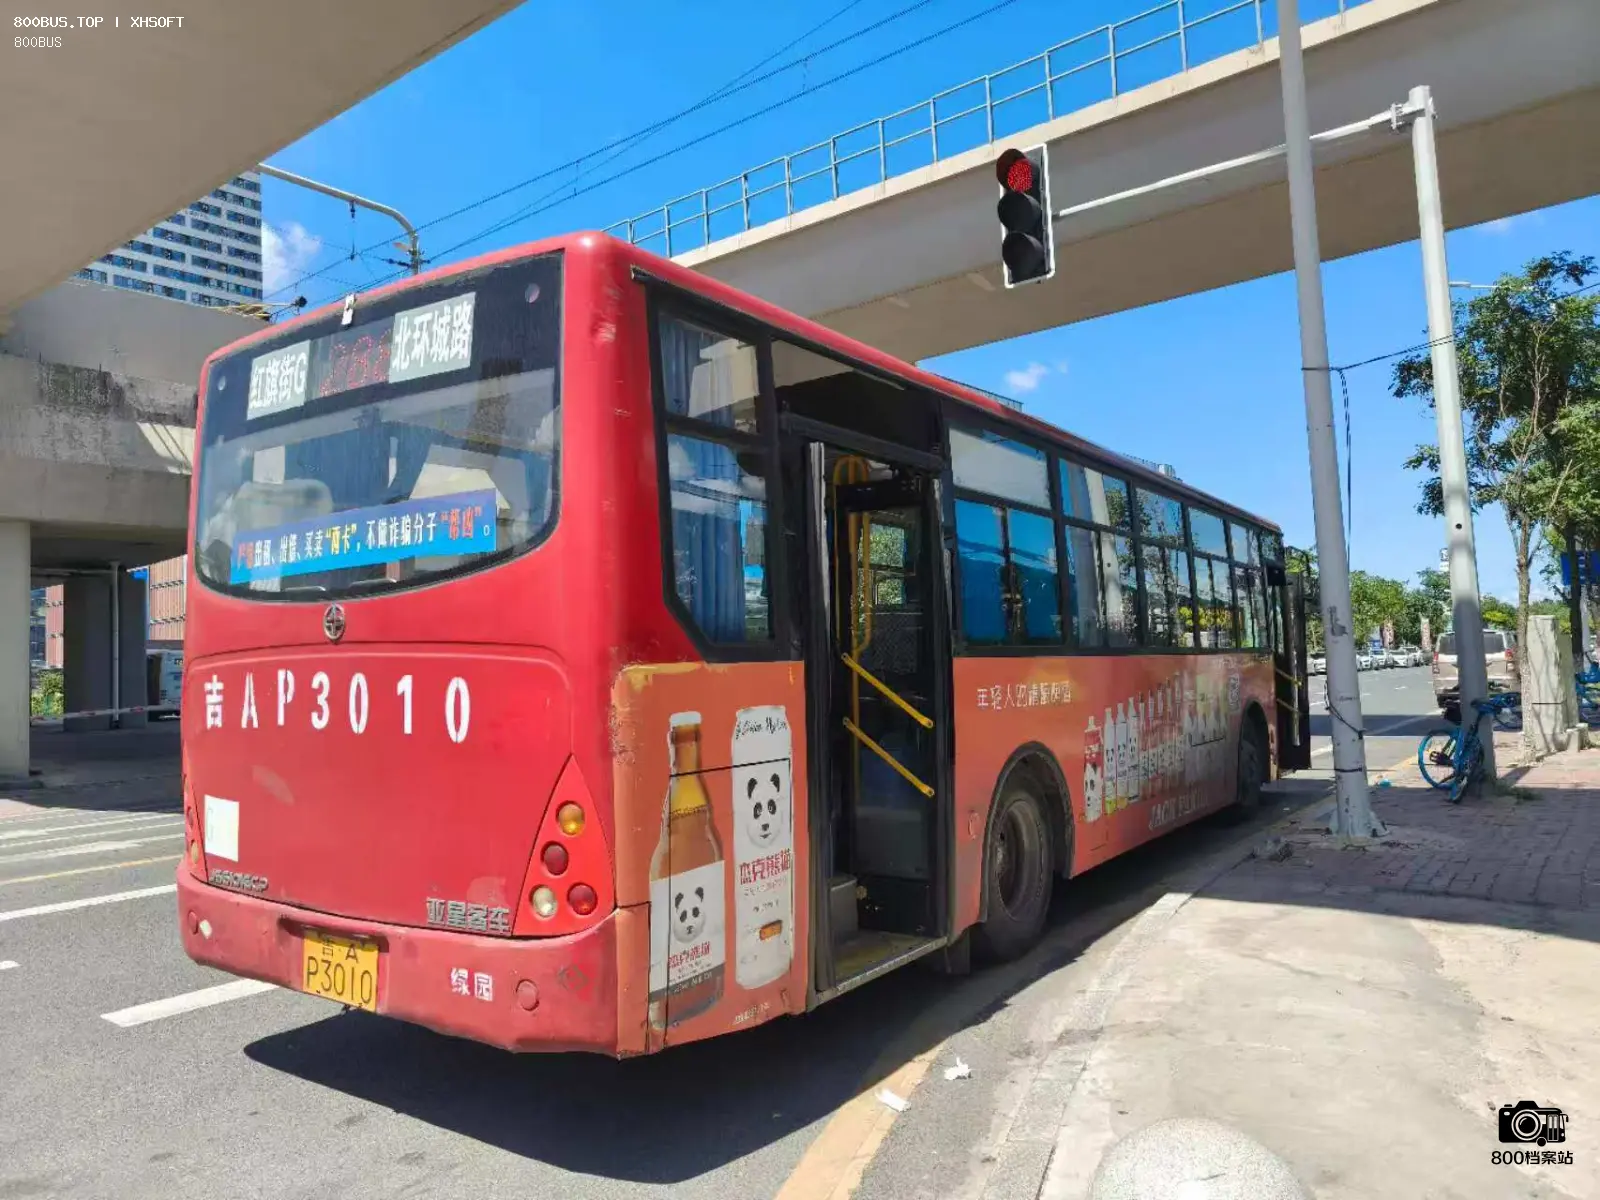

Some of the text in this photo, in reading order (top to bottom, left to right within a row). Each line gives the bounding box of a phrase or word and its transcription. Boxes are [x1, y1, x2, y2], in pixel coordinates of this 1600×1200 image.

[392, 300, 474, 373] 北环城路
[426, 896, 511, 934] 亚星客车
[306, 955, 373, 1005] P3010
[450, 967, 494, 1002] 绿园
